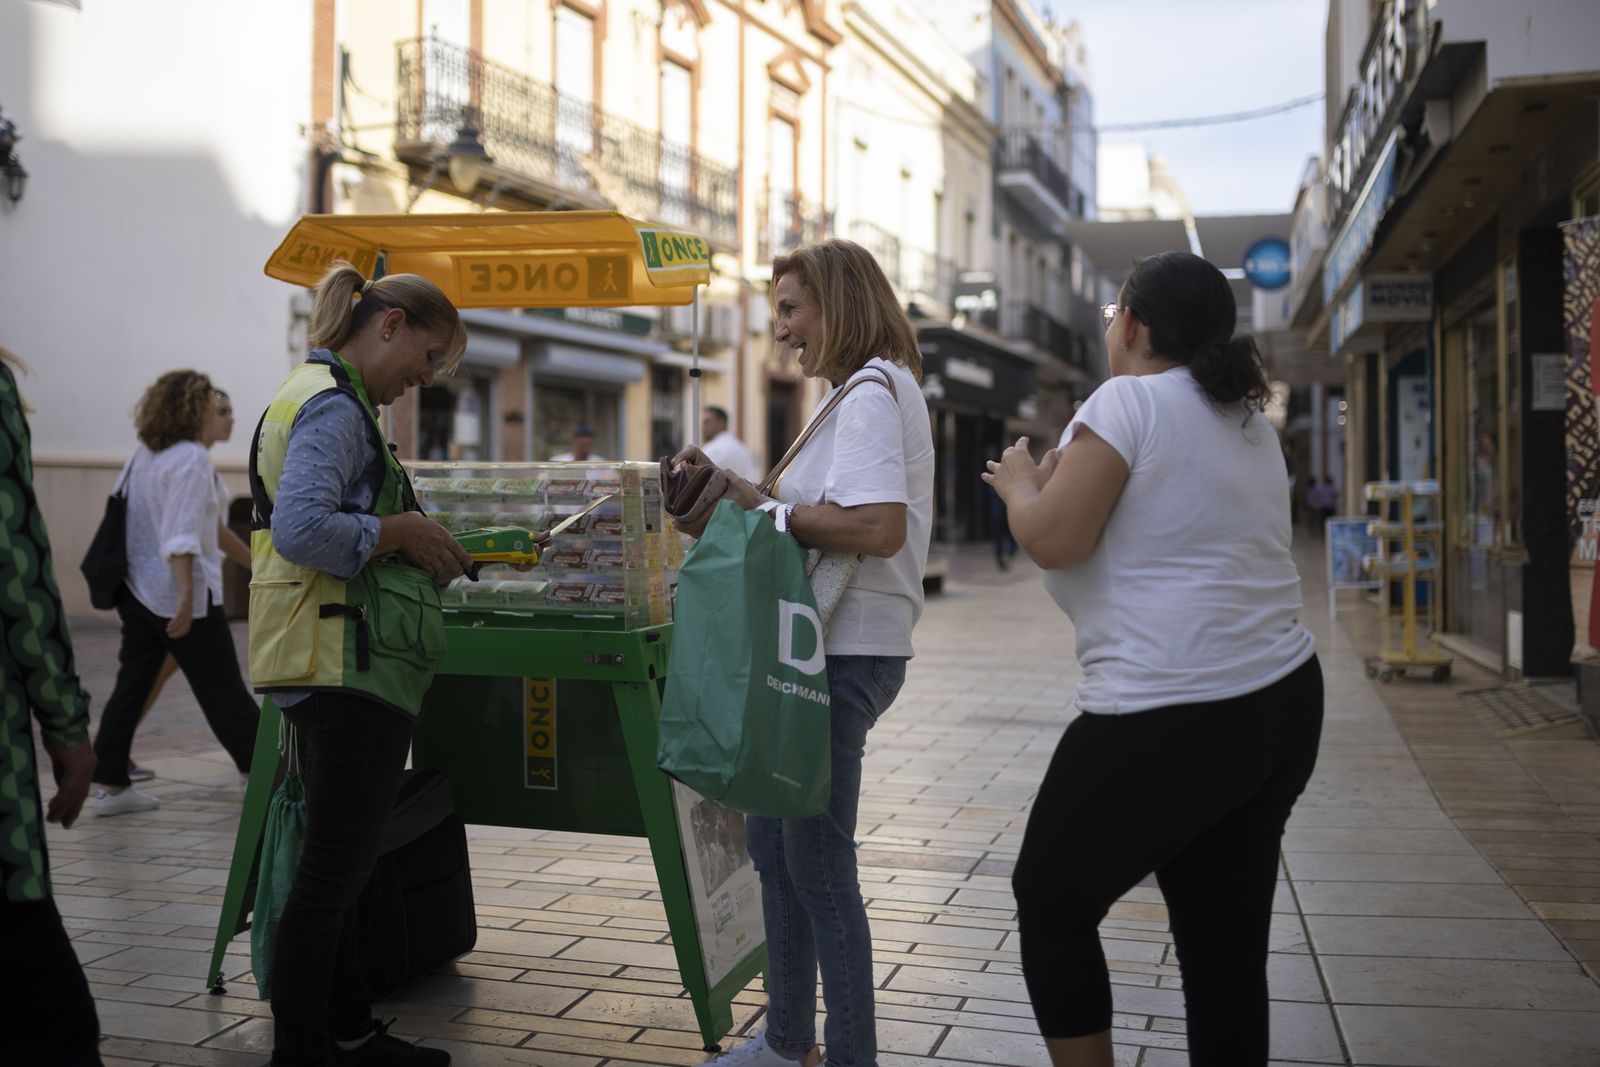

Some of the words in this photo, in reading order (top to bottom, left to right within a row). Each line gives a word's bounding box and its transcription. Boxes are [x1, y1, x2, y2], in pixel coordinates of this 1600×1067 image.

[661, 236, 708, 261] ONCE
[778, 598, 826, 676] D
[530, 677, 551, 751] ONC
